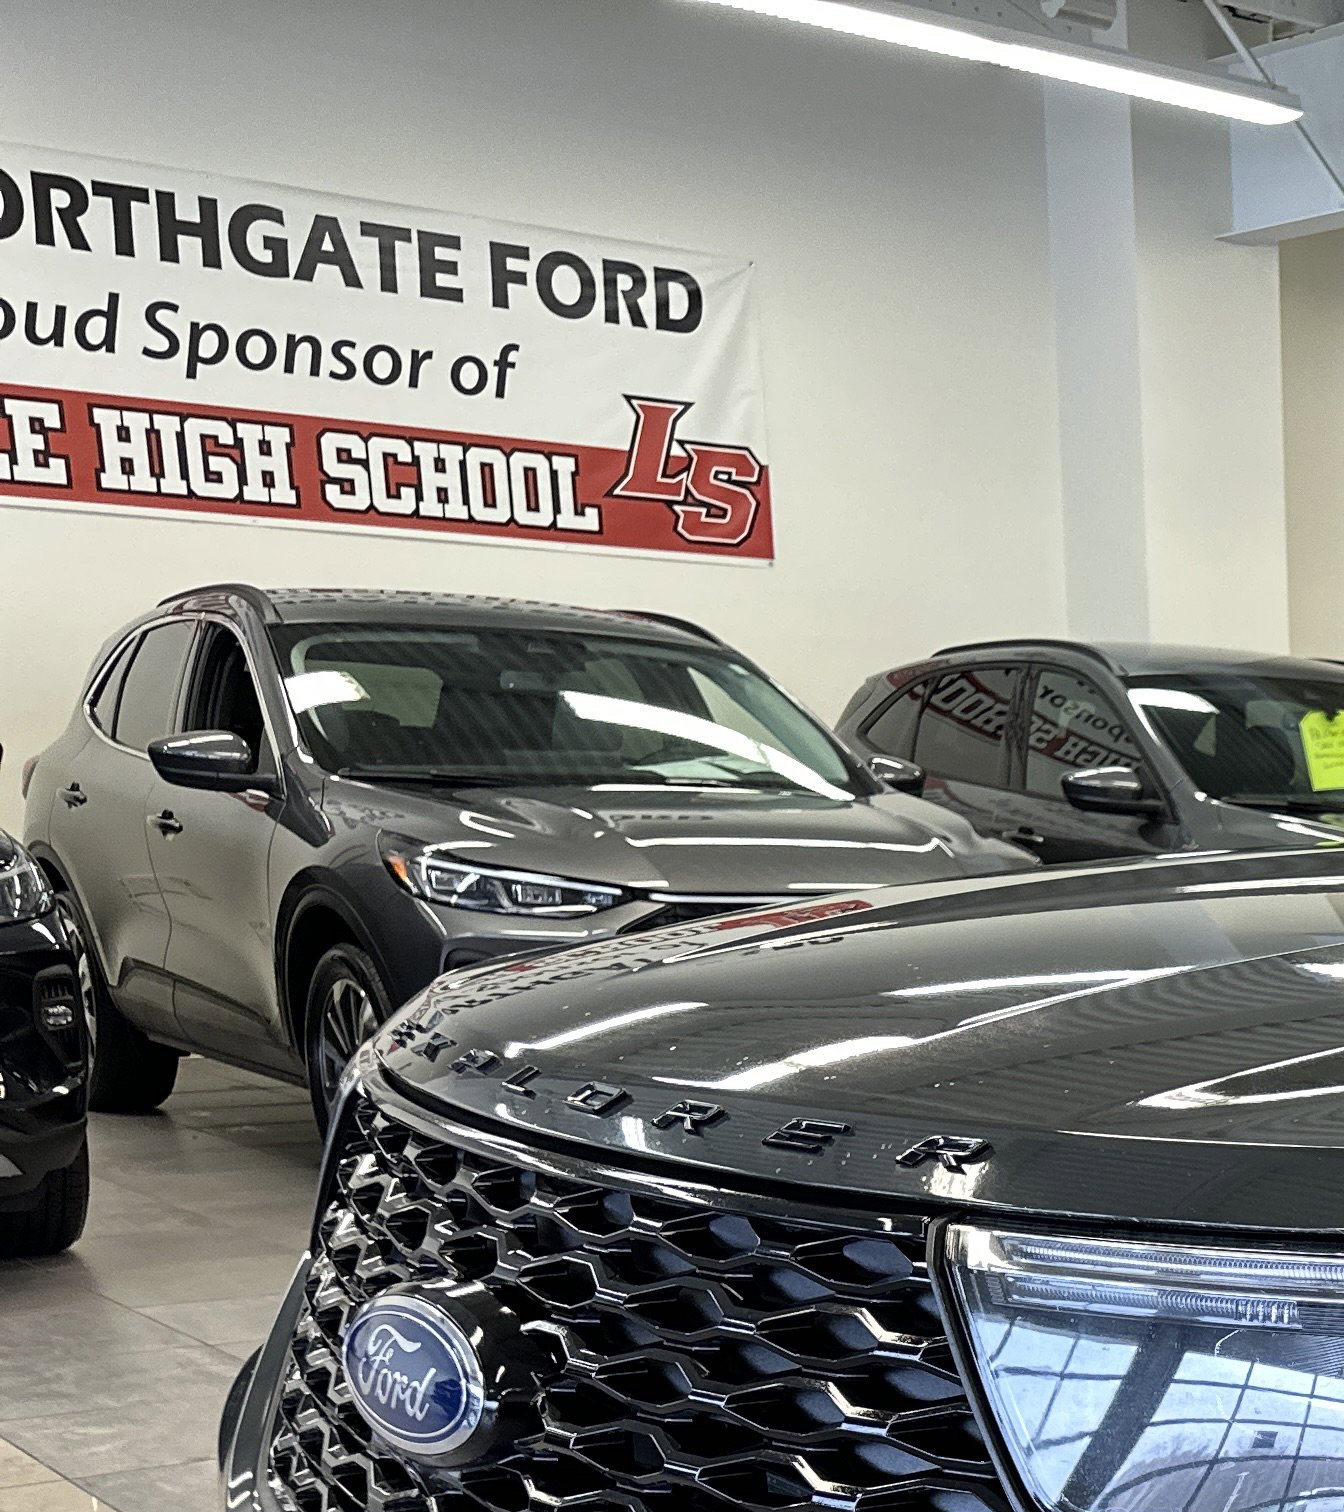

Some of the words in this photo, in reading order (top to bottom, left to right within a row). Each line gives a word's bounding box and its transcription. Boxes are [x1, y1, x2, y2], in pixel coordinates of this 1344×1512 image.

[488, 240, 704, 335] FORD
[142, 300, 433, 390] Sponsor
[450, 343, 520, 399] of
[90, 401, 301, 510] HIGH
[316, 428, 604, 537] SCHOOL
[603, 393, 767, 547] LS
[359, 1324, 431, 1423] Ford
